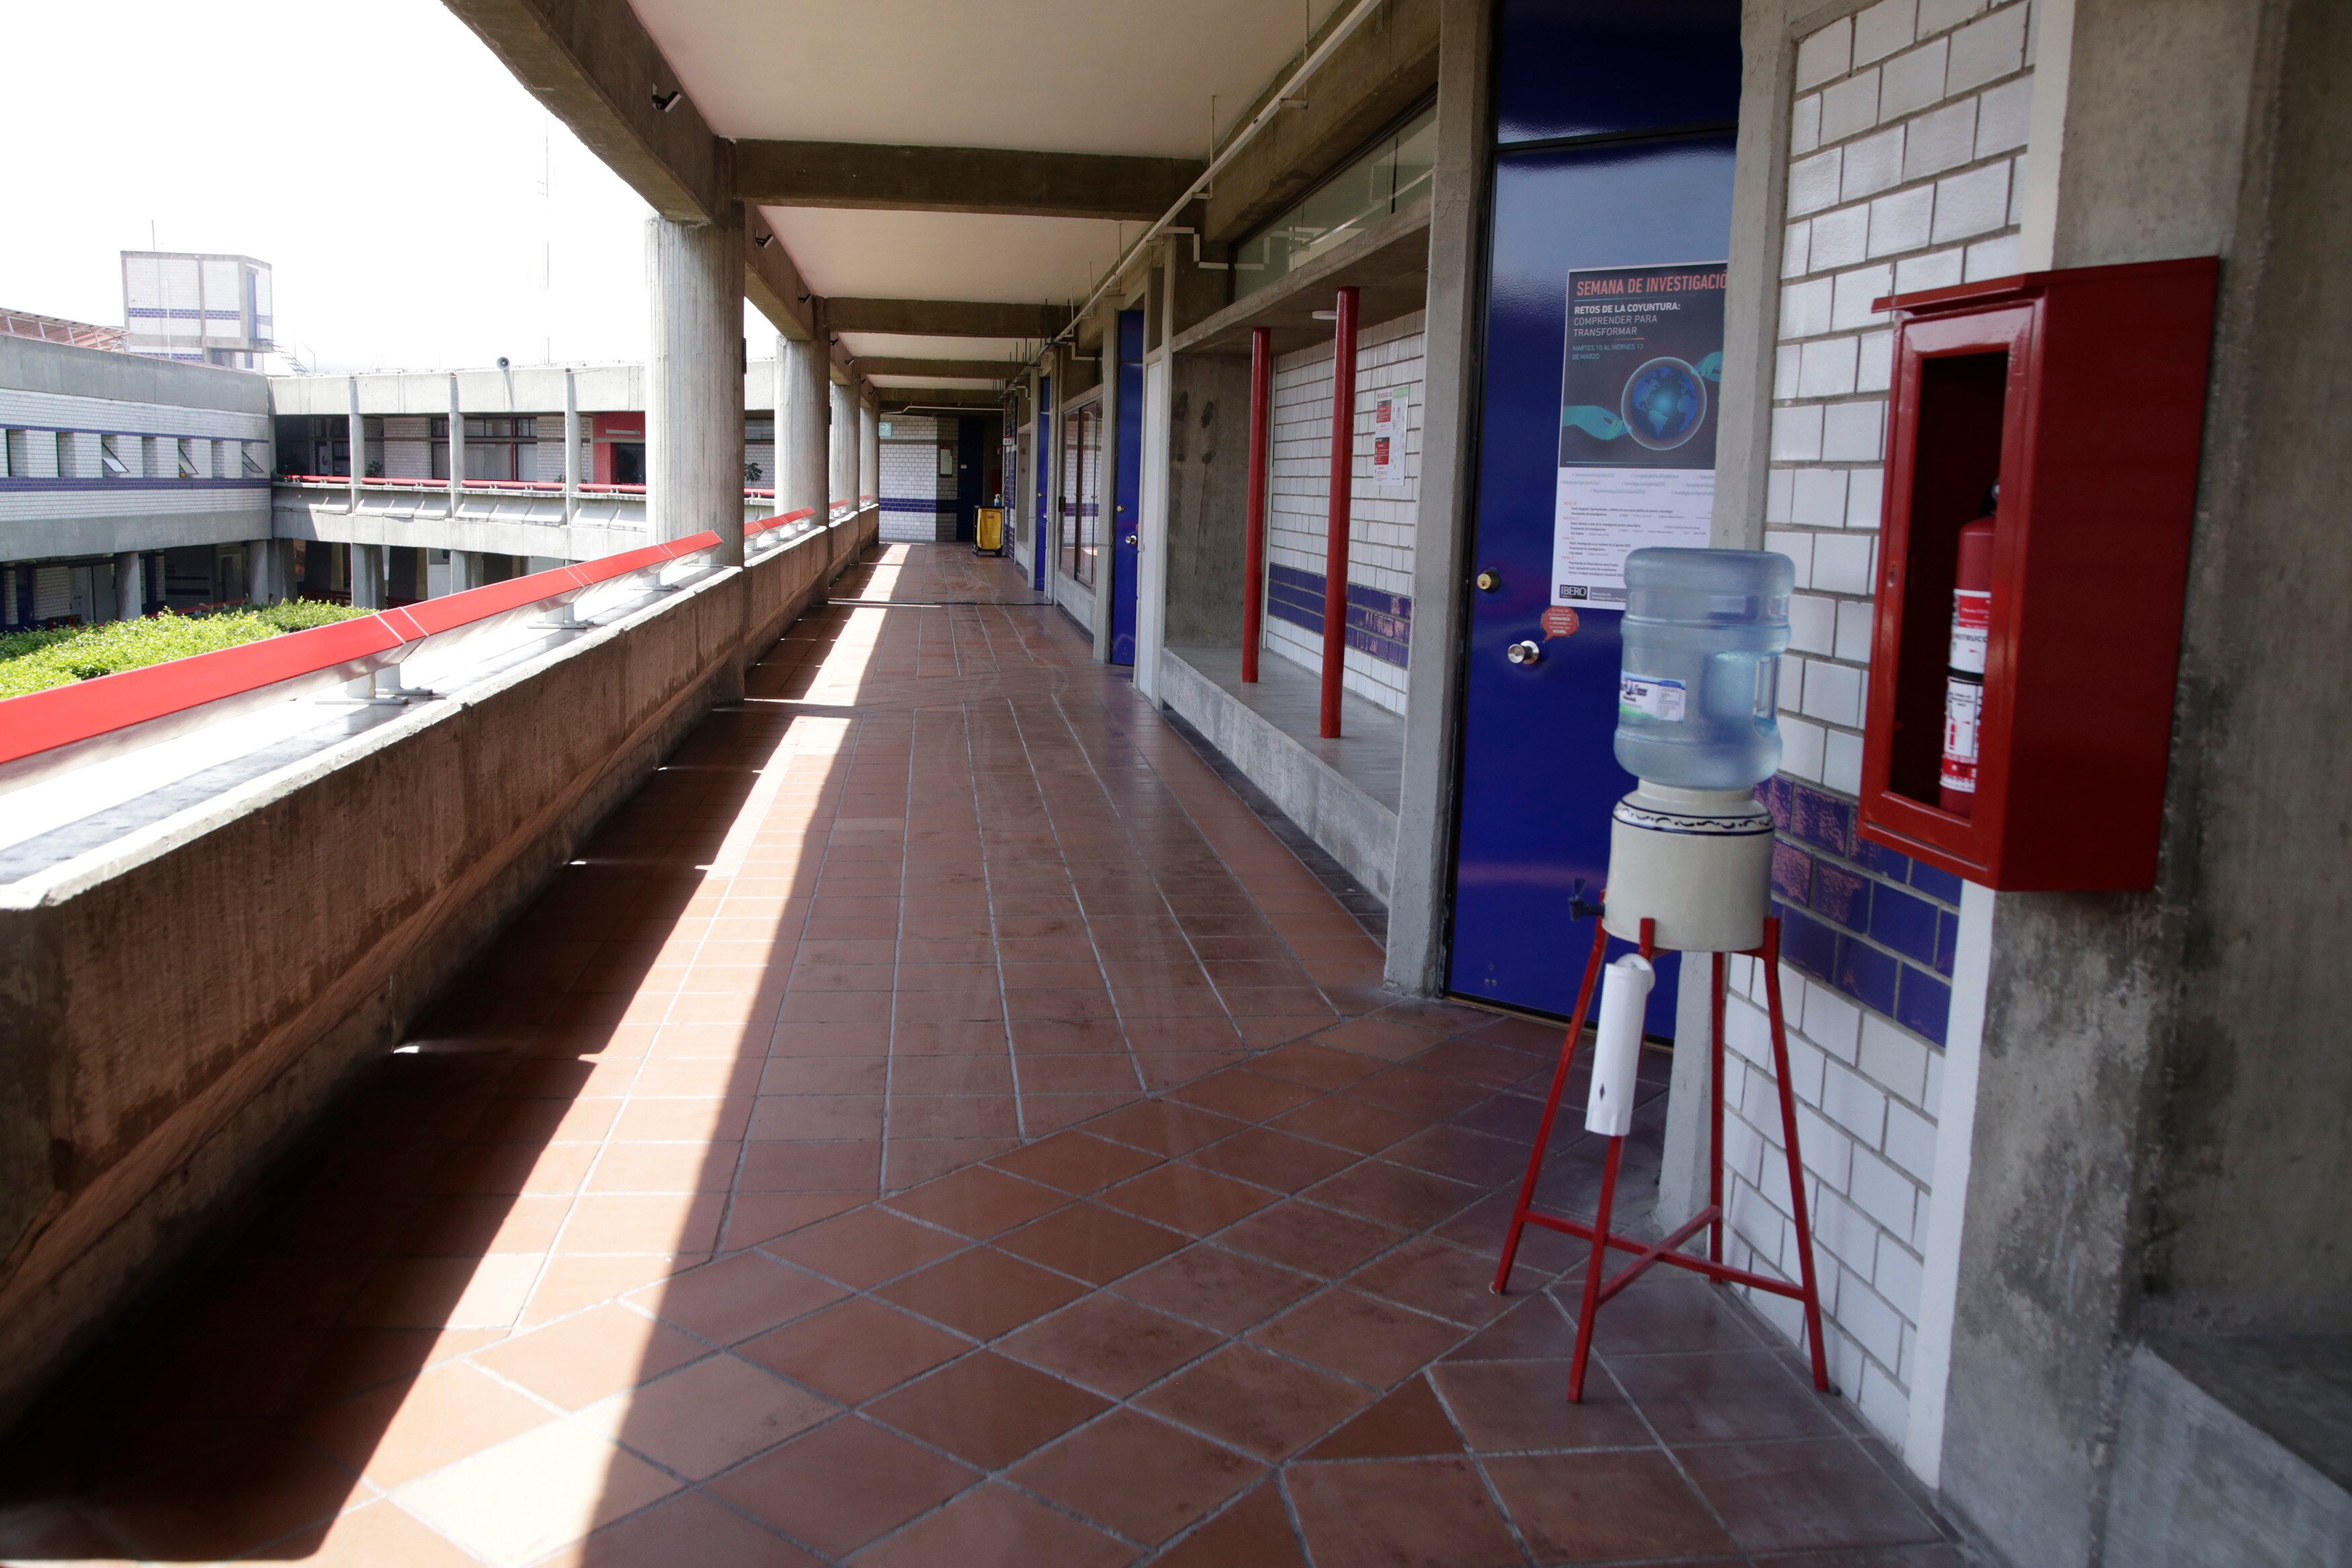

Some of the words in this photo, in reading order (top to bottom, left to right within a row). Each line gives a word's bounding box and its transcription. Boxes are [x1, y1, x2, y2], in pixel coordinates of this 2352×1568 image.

[1577, 279, 1624, 296] SEMANA
[1628, 277, 1644, 294] DE
[1574, 305, 1601, 314] RETOS
[1601, 304, 1613, 314] DE
[1614, 304, 1626, 313] LA
[1627, 302, 1681, 312] COYUNTURA:
[1574, 315, 1632, 326] COMPRENDER
[1634, 314, 1658, 323] PARA
[1574, 326, 1638, 337] TRANSFORMAR
[1560, 586, 1587, 597] IBERO
